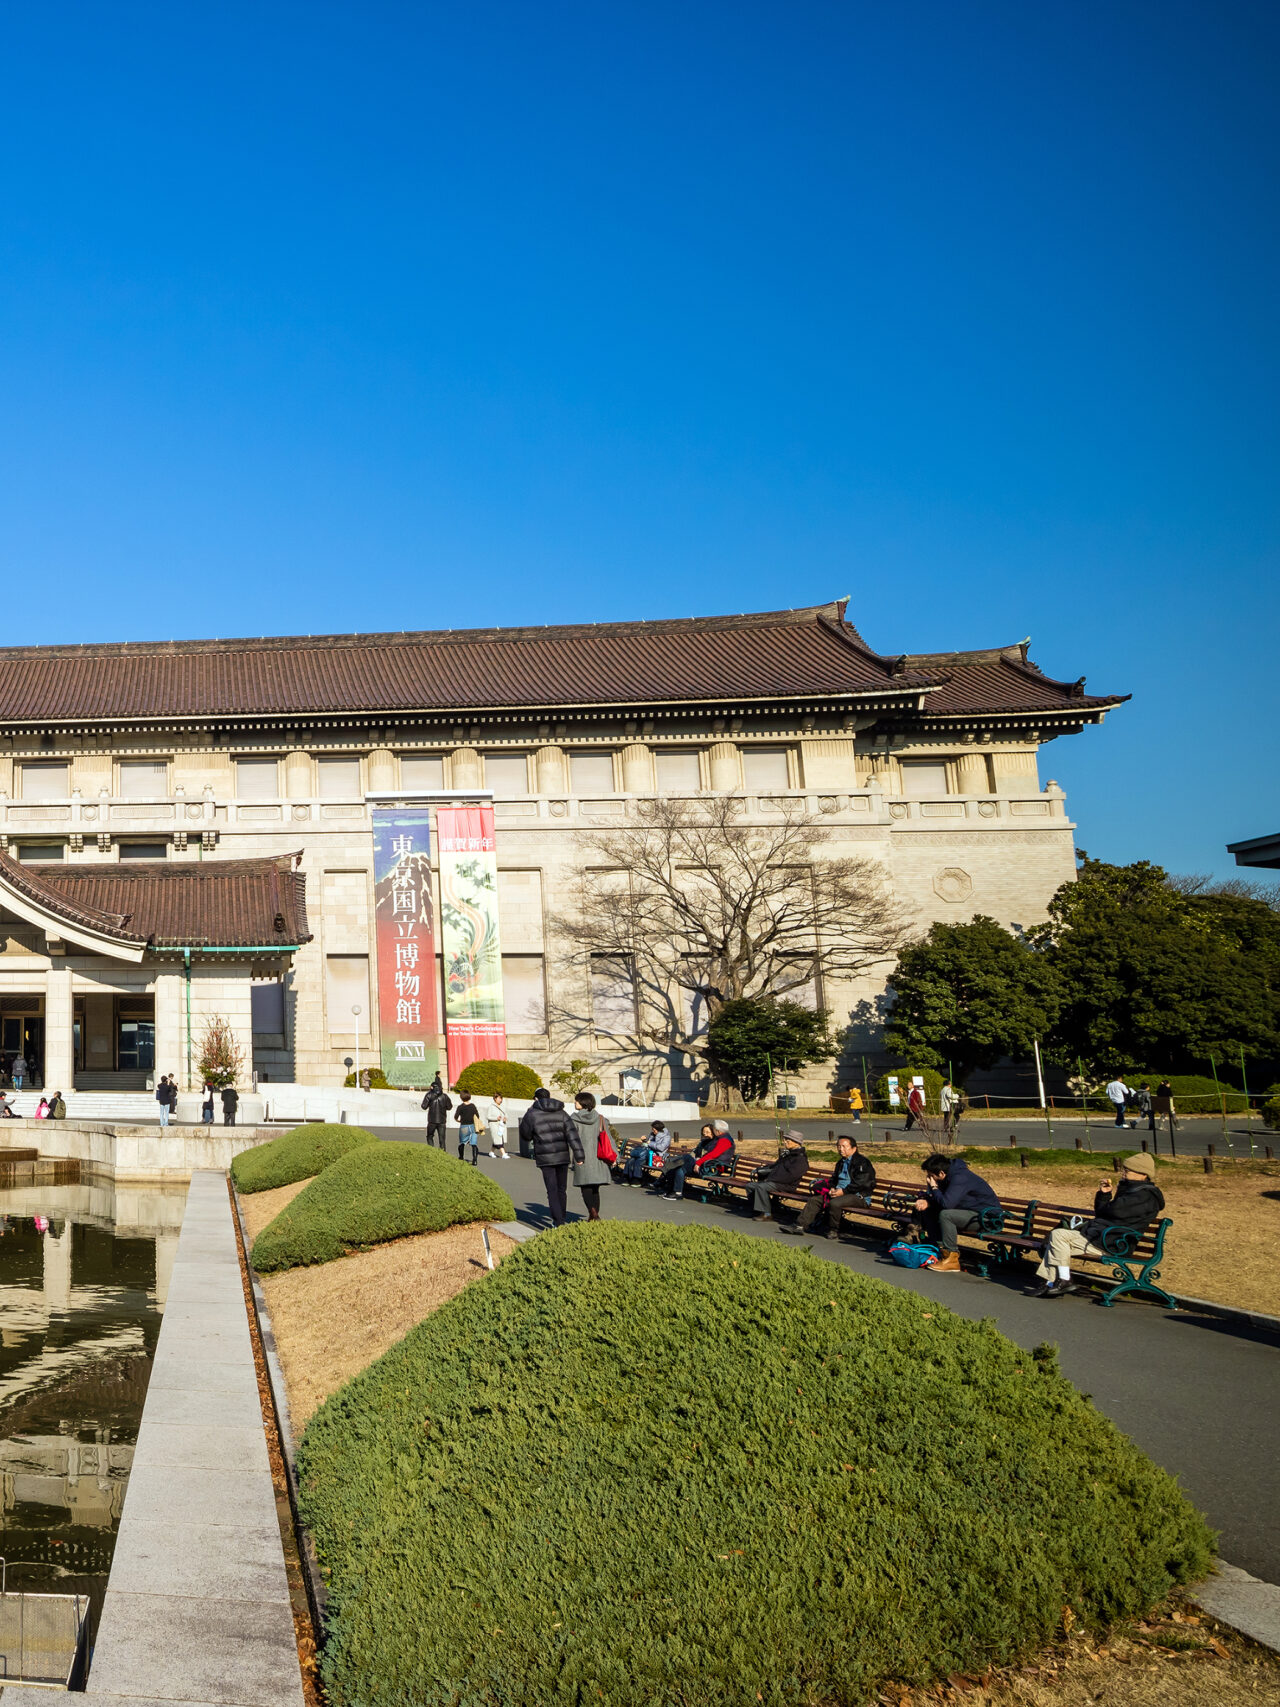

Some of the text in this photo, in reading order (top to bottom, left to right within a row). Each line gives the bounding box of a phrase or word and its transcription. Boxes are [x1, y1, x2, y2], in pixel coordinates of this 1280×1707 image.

[389, 834, 421, 1025] 東京国立博物館
[395, 1045, 425, 1057] TNM
